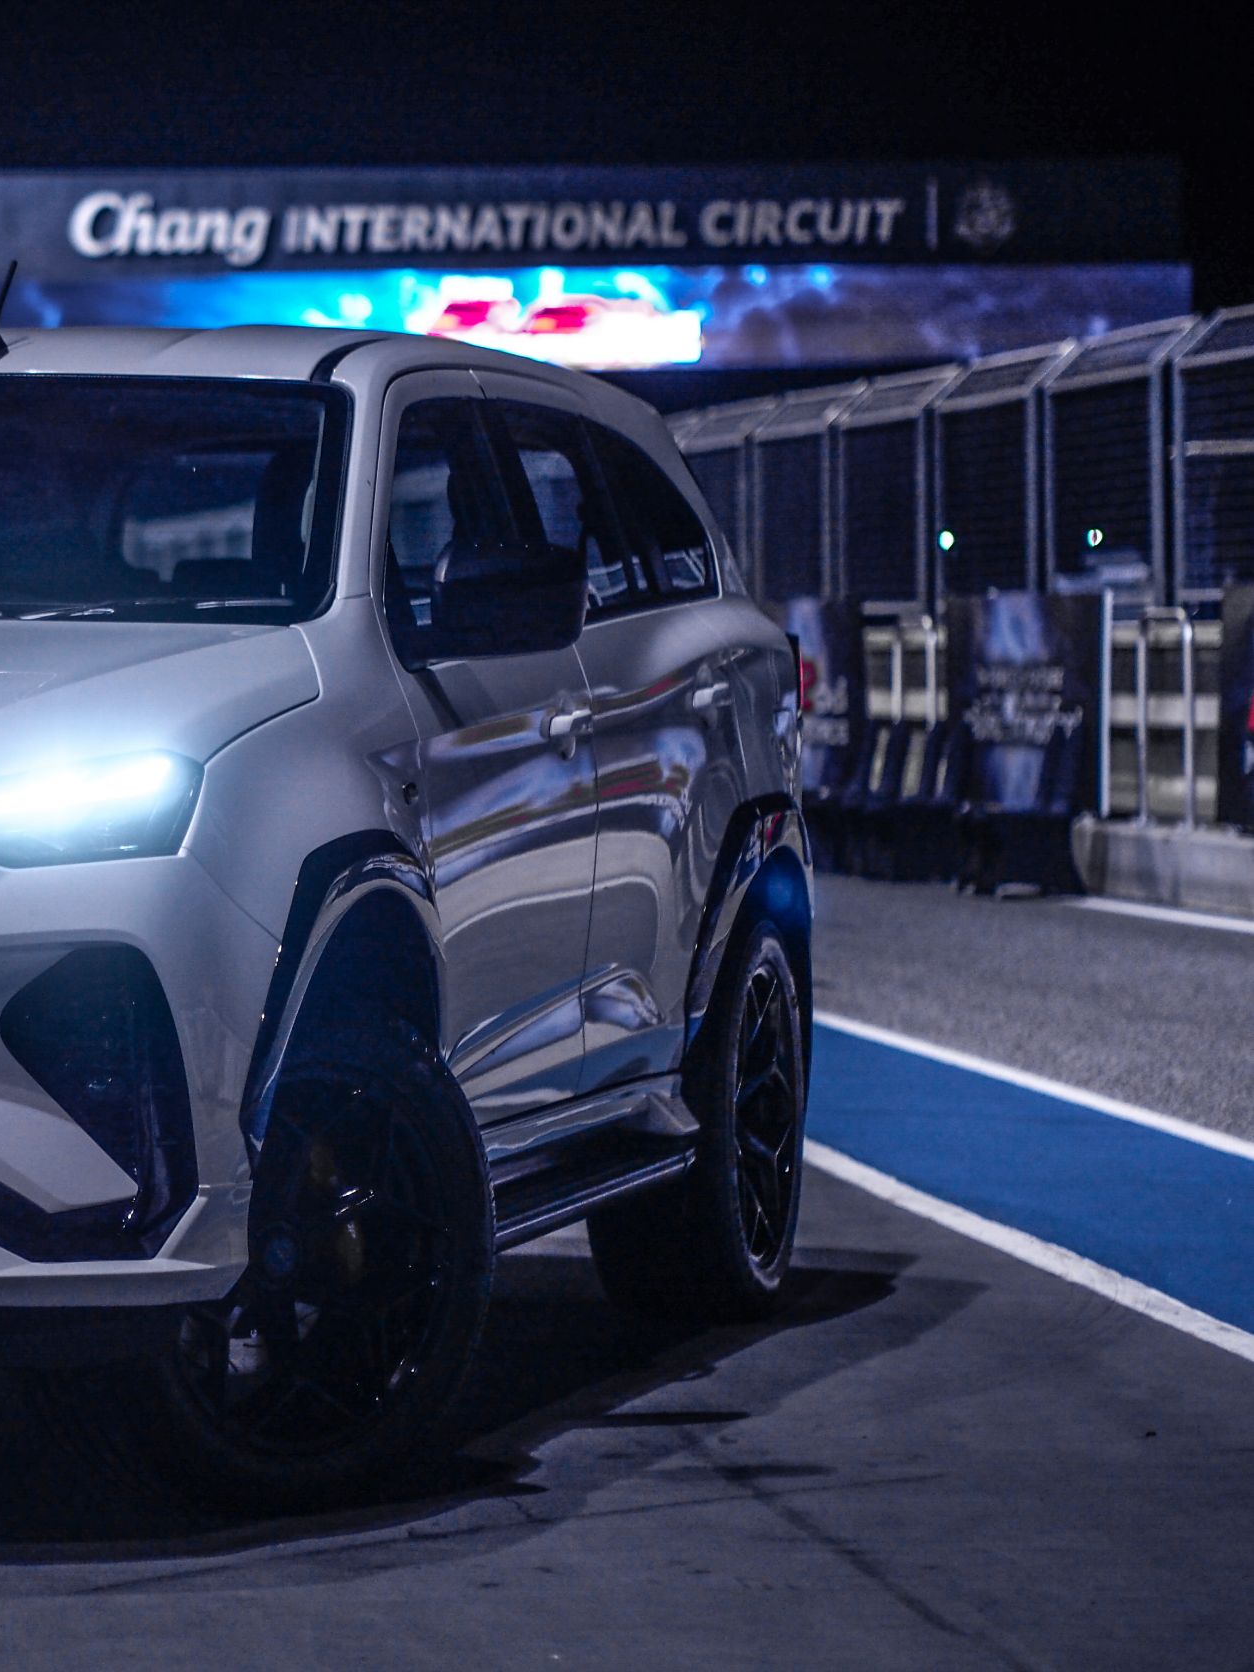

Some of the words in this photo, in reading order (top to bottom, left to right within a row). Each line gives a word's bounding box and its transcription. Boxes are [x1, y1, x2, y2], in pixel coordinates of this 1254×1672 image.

[68, 191, 271, 267] Chang
[283, 202, 688, 250] INTERNATIONAL
[699, 198, 906, 245] CIRCUIT
